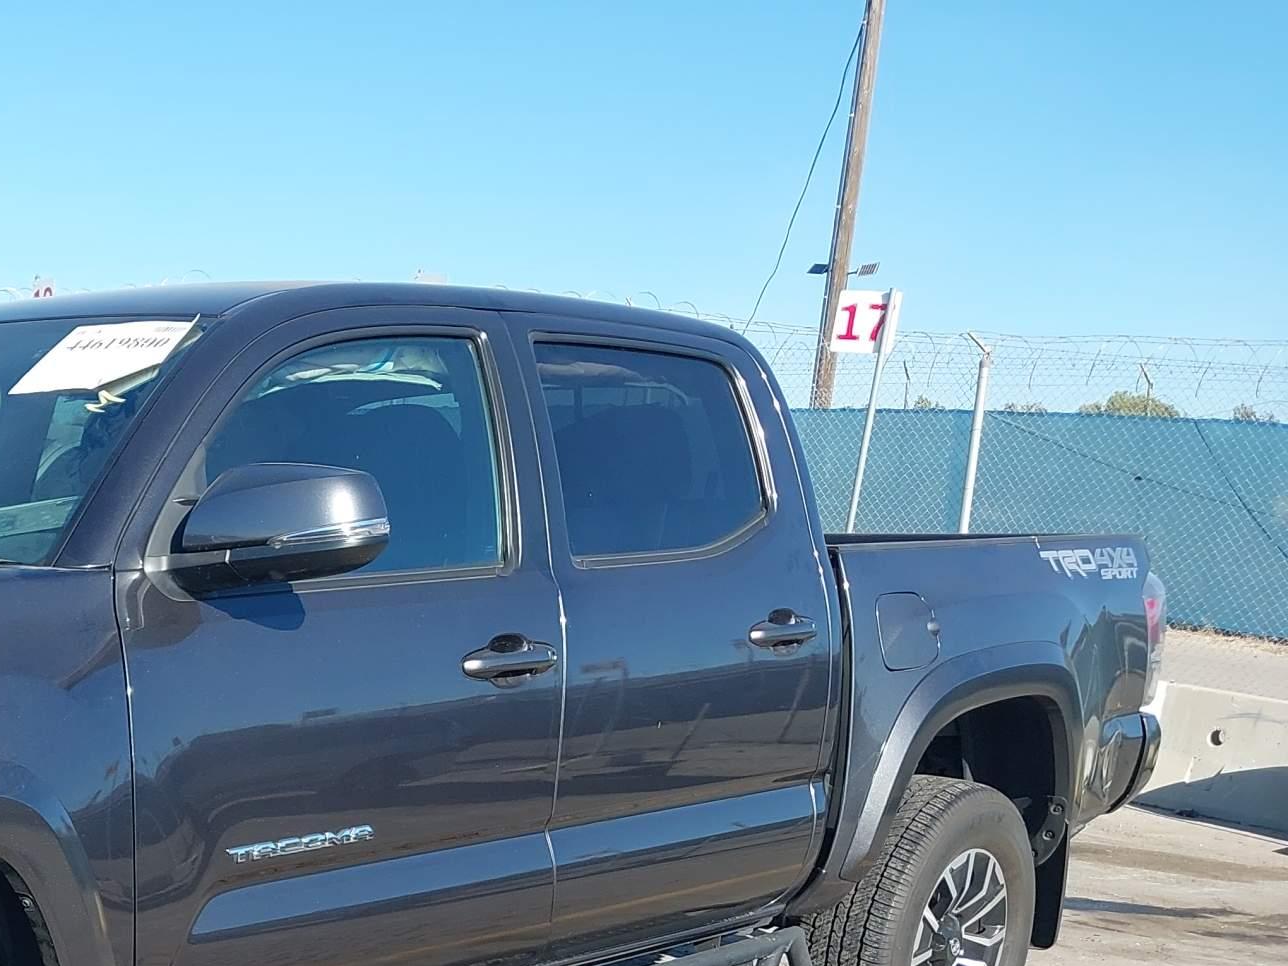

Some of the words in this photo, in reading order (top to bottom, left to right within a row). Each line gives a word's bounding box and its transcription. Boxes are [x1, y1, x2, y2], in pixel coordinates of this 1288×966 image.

[837, 303, 888, 341] 17
[1039, 549, 1097, 579] TRD
[1100, 567, 1138, 579] SPORT
[225, 824, 376, 864] TACOMA
